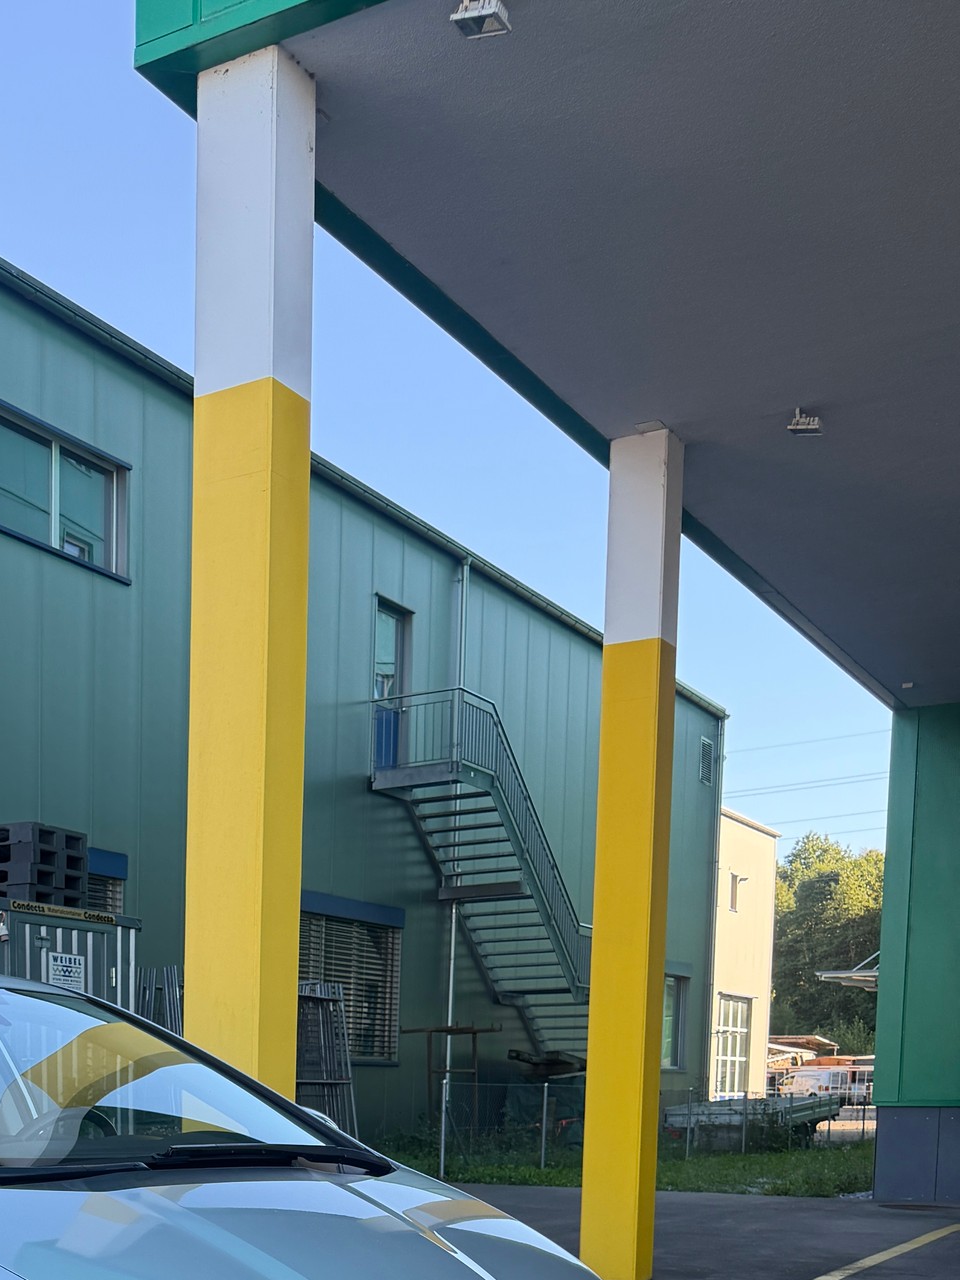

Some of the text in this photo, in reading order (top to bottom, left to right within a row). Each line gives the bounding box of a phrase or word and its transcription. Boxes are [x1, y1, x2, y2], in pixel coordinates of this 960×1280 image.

[12, 901, 45, 913] Condecta
[83, 911, 114, 923] Condecta
[52, 955, 82, 966] WEIBEL
